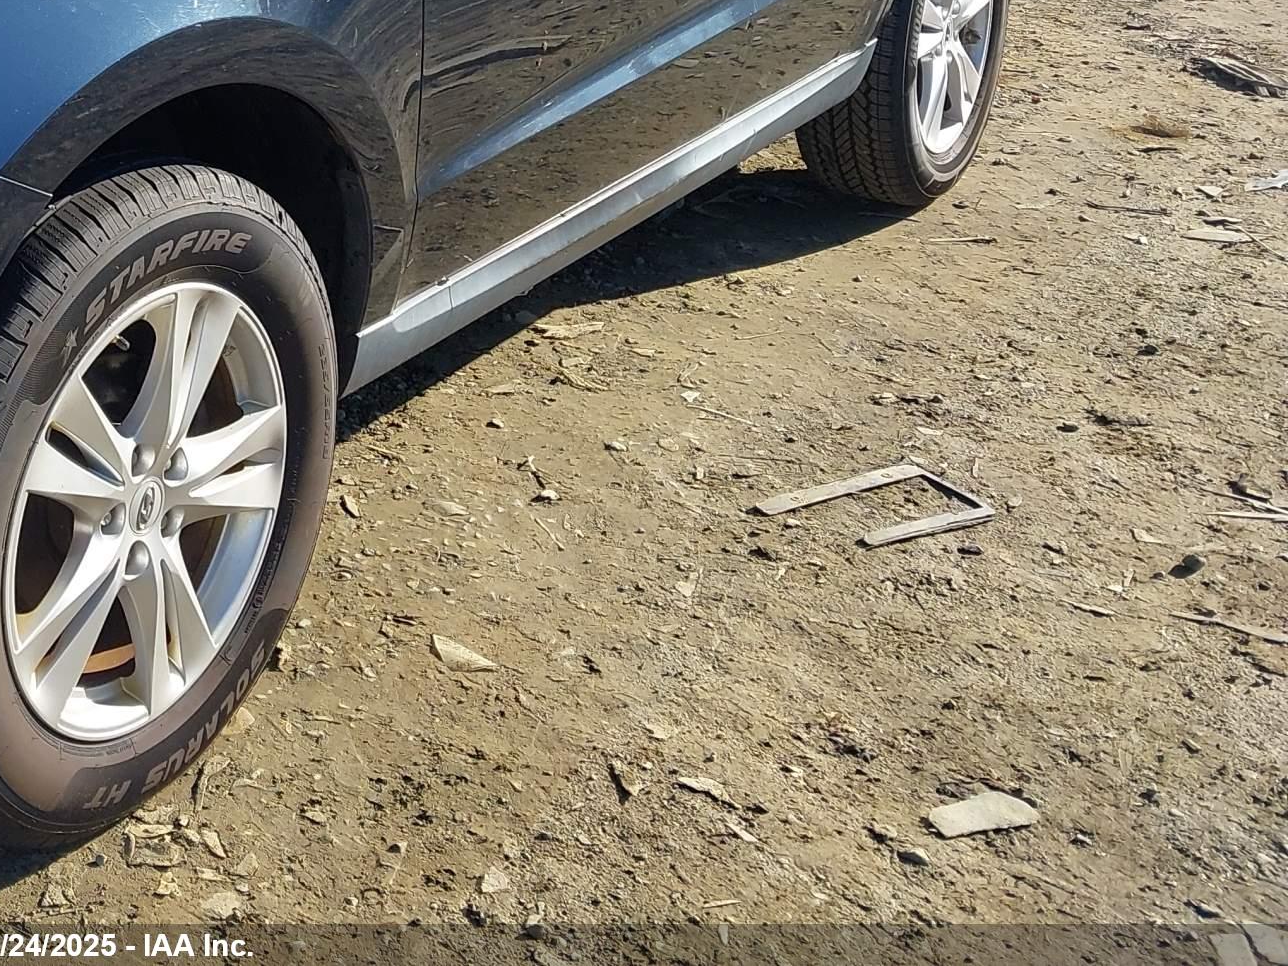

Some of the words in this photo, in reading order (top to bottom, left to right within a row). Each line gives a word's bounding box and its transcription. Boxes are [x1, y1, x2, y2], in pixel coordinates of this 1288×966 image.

[84, 229, 252, 335] STARFIRE
[141, 638, 265, 794] SOLARUS
[83, 780, 132, 810] HT
